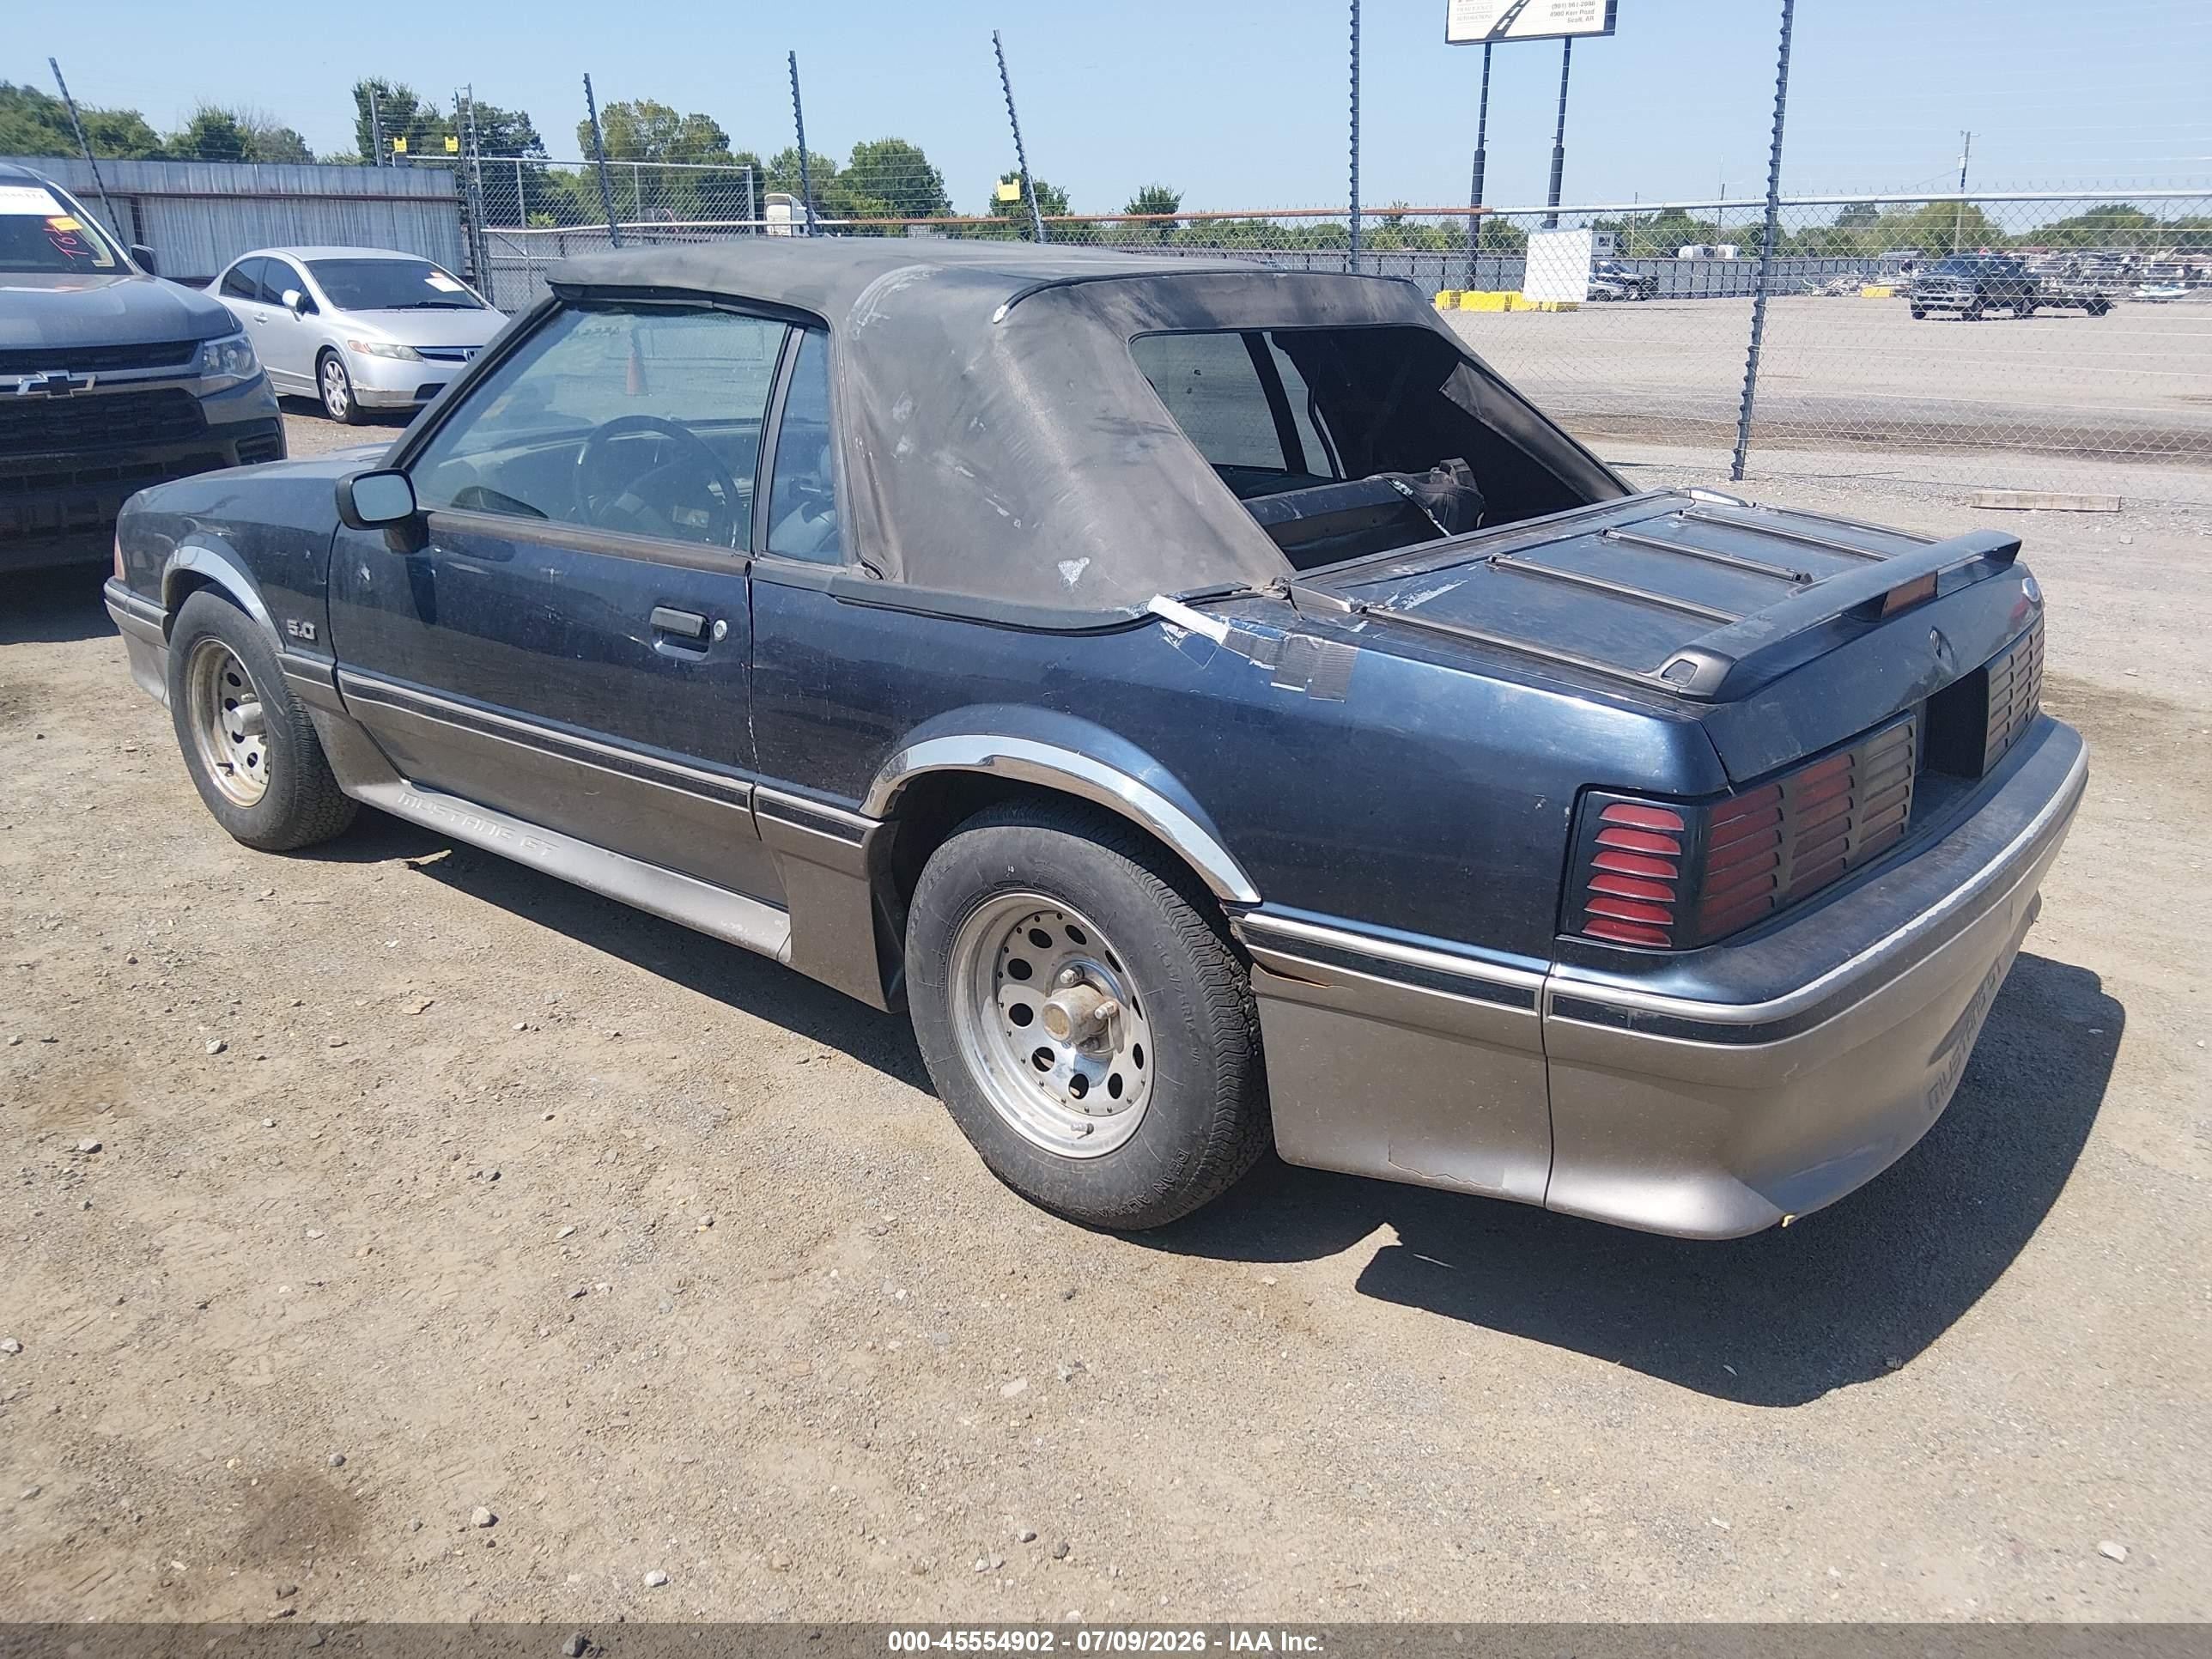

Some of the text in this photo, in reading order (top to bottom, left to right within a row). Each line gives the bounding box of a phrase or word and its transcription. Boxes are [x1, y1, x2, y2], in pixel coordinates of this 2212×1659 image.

[287, 618, 317, 641] 5.0
[398, 792, 560, 856] MUSTANG GT
[1152, 1147, 1190, 1196] DEAN
